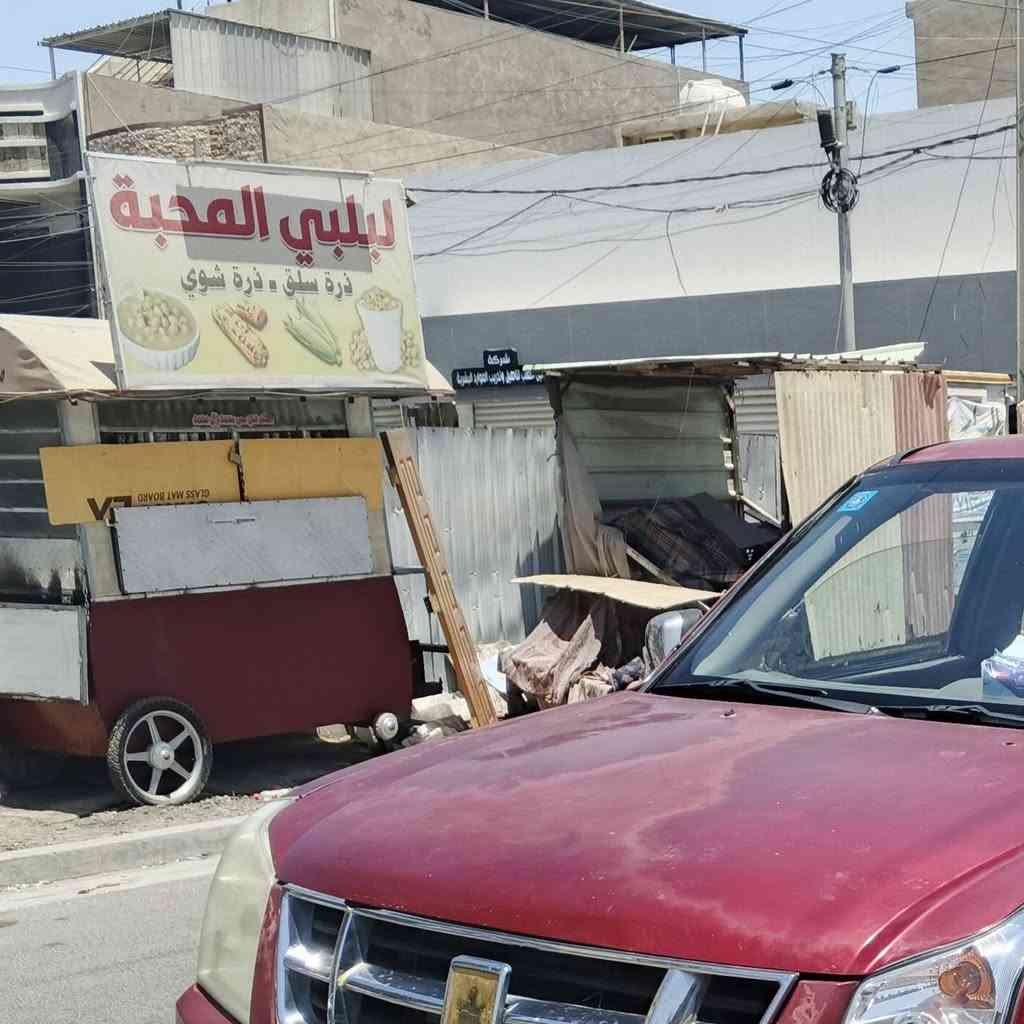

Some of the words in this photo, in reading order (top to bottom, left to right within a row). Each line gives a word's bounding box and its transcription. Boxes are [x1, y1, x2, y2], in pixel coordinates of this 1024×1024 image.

[110, 173, 271, 249] المحبة
[279, 193, 398, 267] لبلبي
[181, 264, 226, 299] شوي
[232, 266, 264, 297] ذرة
[282, 268, 319, 296] سلق
[325, 271, 353, 298] ذرة
[487, 352, 511, 367] شركة
[137, 492, 165, 503] BOARD
[167, 489, 185, 501] MAT
[186, 488, 210, 499] GLASS
